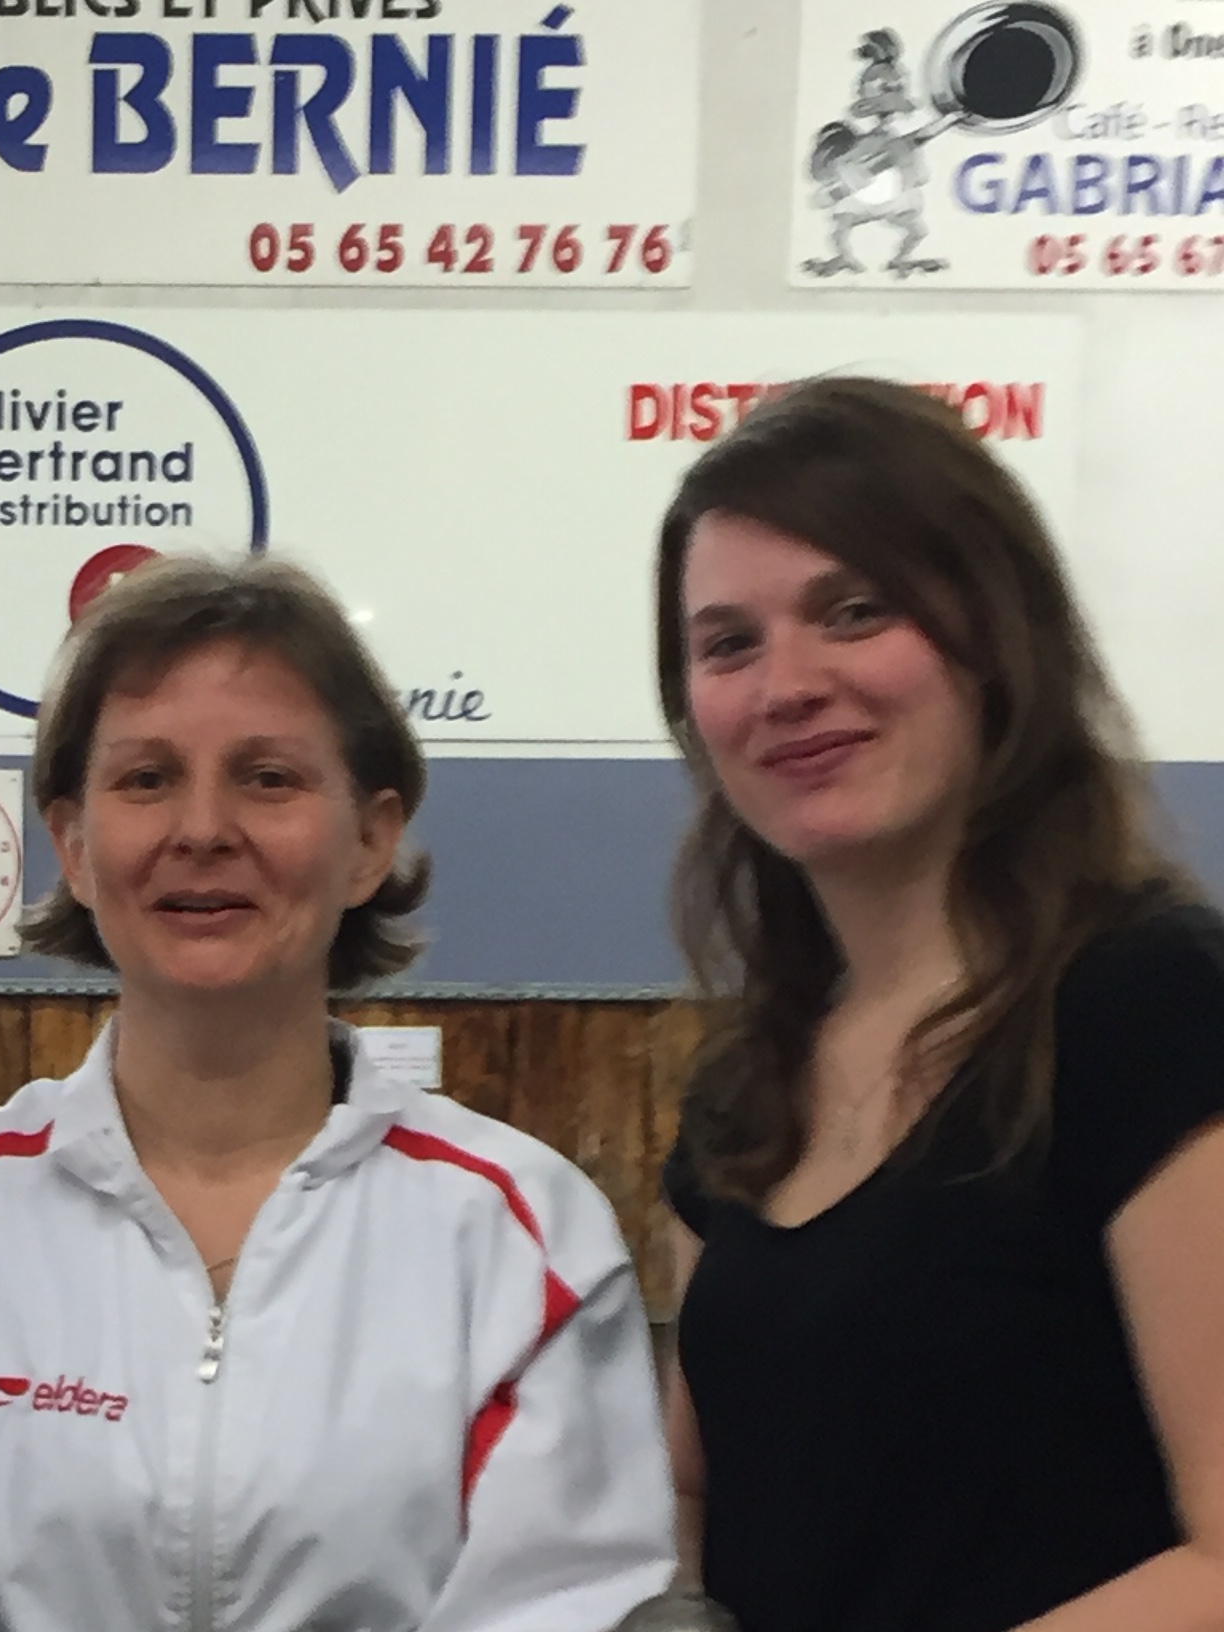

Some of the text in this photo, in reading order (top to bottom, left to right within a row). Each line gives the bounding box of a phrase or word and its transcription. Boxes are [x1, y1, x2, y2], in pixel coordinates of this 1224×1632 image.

[88, 4, 588, 194] BERNIÉ
[956, 152, 1224, 216] GABRIA
[248, 222, 673, 275] 05 65 42 76 76
[1026, 233, 1089, 277] 05
[1099, 233, 1162, 277] 65
[31, 1374, 129, 1421] eldera
